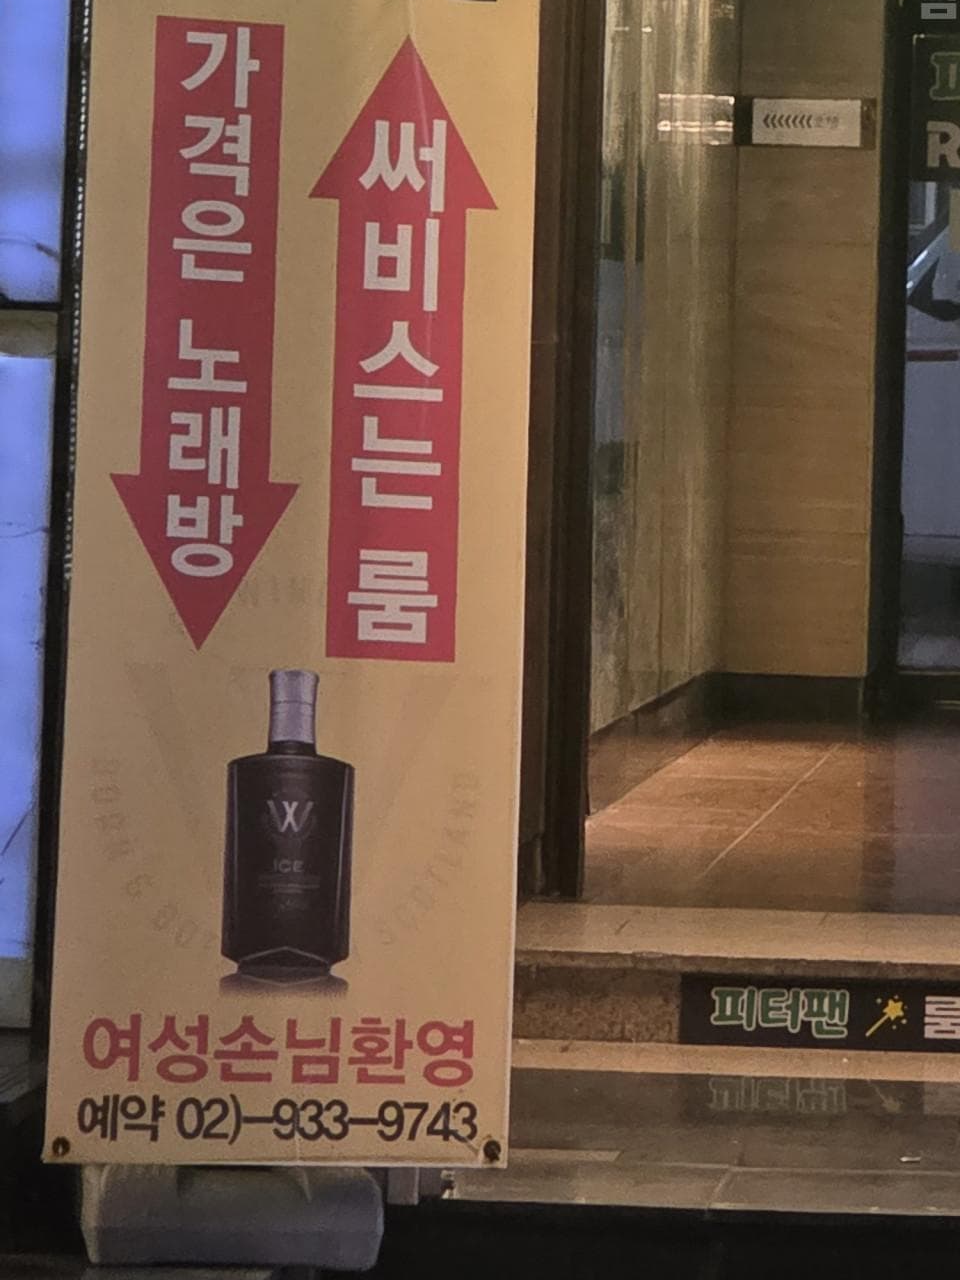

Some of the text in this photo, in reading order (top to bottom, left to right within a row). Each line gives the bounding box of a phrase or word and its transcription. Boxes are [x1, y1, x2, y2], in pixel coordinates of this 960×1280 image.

[166, 26, 260, 578] 가격은 노래방
[347, 119, 447, 644] 써비스는 룸
[273, 859, 304, 873] ICE
[710, 986, 849, 1039] 피터팬
[82, 1013, 475, 1087] 여성손님환영
[77, 1094, 166, 1142] 예약
